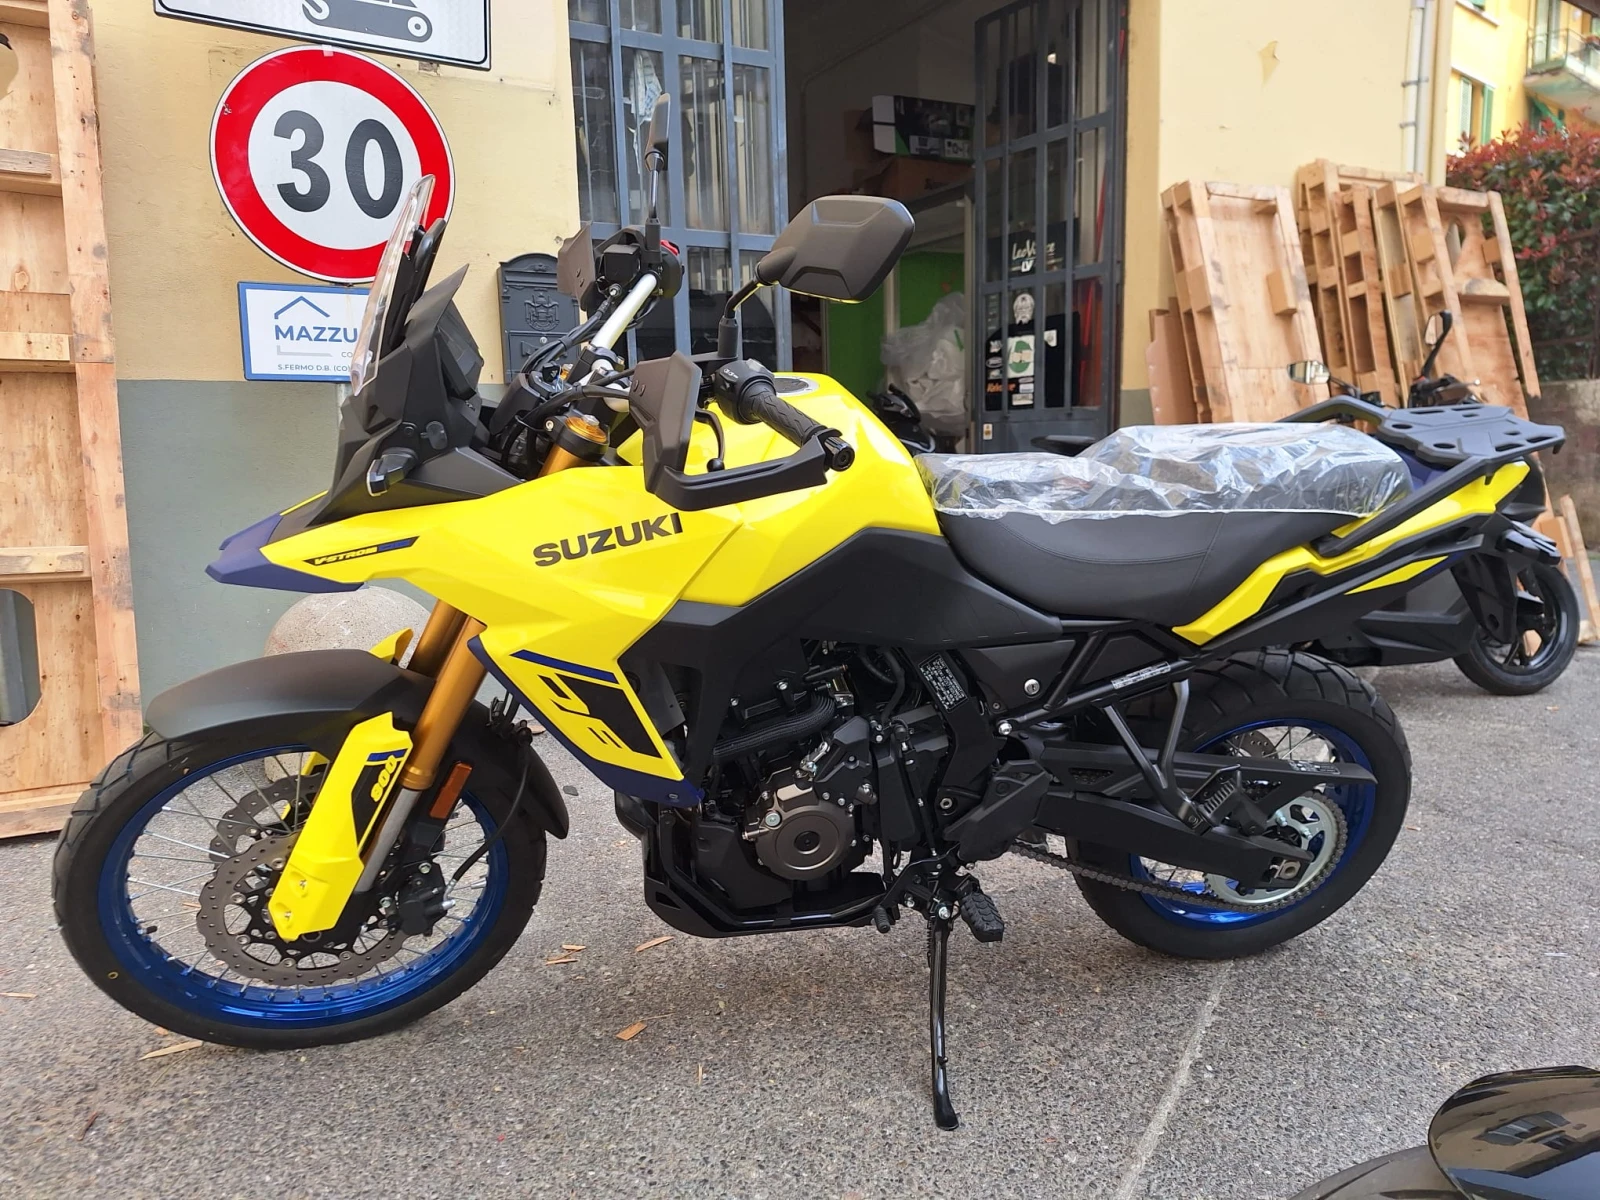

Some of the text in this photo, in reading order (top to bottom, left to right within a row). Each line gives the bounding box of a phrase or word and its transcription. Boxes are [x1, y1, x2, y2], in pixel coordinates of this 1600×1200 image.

[273, 110, 403, 219] 30
[533, 512, 683, 566] SUZUKI
[370, 754, 397, 802] 800
